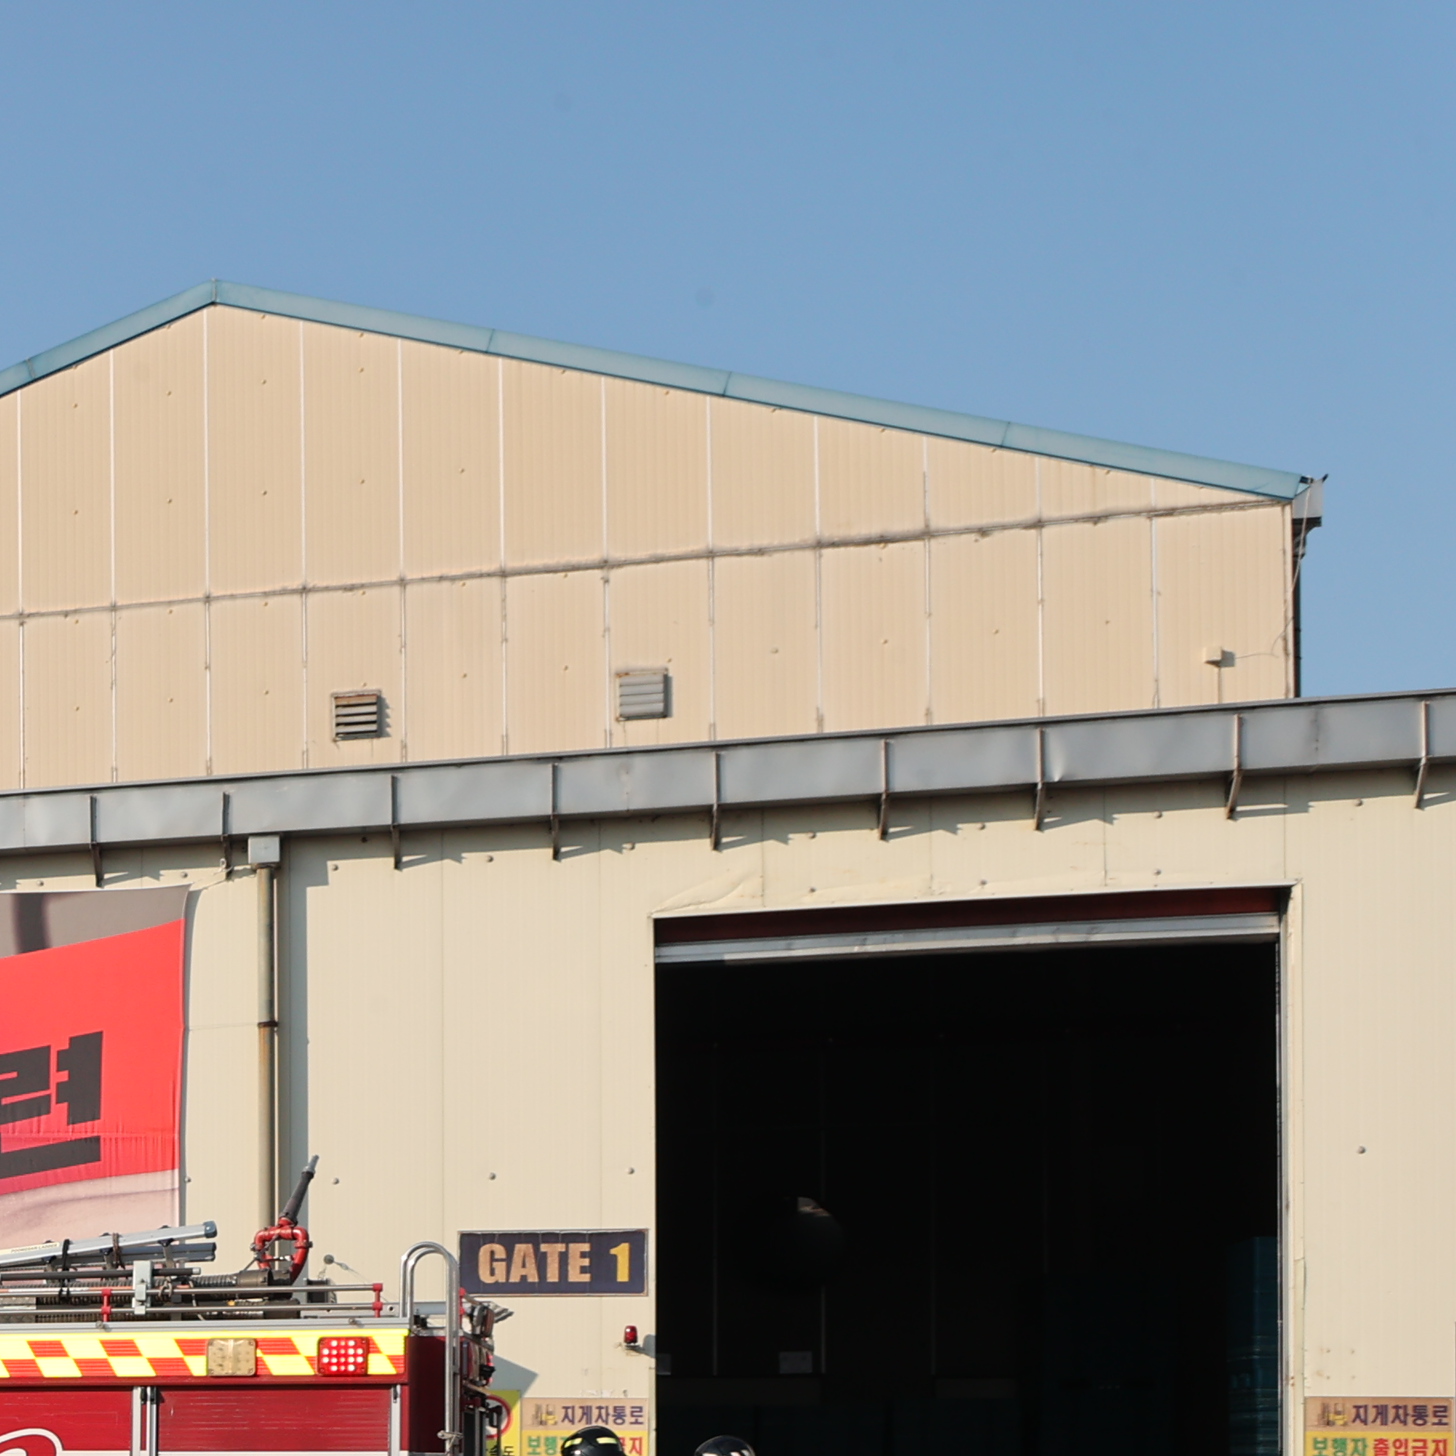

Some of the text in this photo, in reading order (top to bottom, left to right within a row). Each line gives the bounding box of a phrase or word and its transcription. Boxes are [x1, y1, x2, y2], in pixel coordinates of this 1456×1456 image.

[478, 1242, 630, 1284] GATE 1
[561, 1405, 644, 1426] 지게차통로
[1351, 1404, 1449, 1426] 지게차통로
